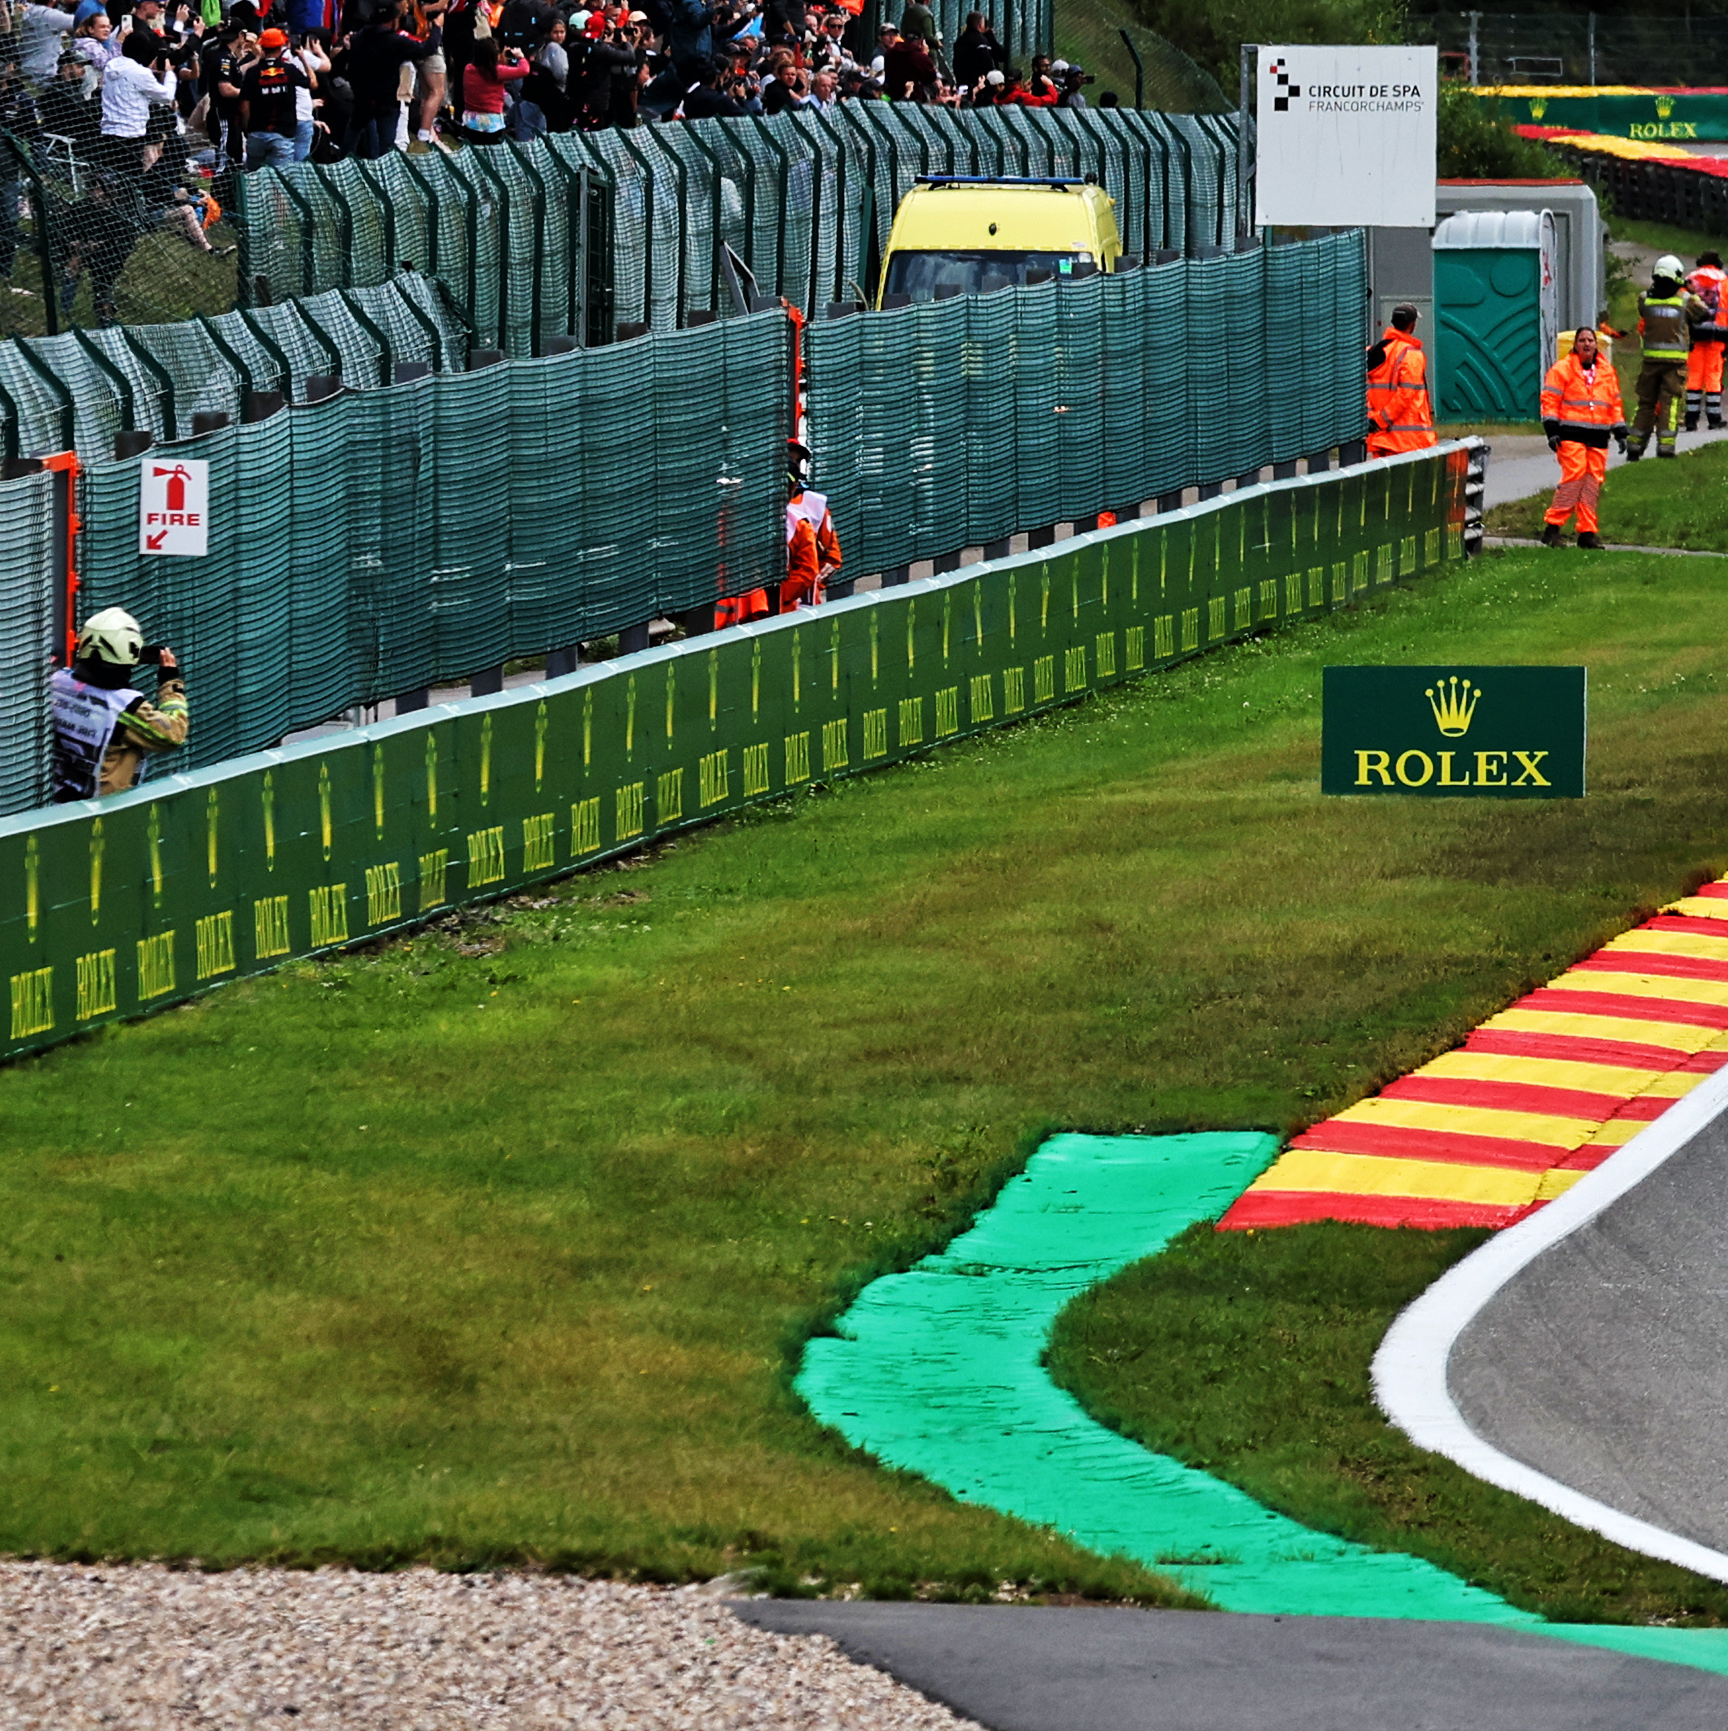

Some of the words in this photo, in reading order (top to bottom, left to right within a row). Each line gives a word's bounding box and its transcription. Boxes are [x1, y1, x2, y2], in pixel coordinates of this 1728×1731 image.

[1308, 85, 1365, 98] CIRCUIT
[1369, 85, 1388, 97] DE
[1392, 84, 1421, 98] SPA
[1629, 123, 1696, 139] ROLEX
[146, 512, 200, 526] FIRE
[1356, 750, 1550, 786] ROLEX
